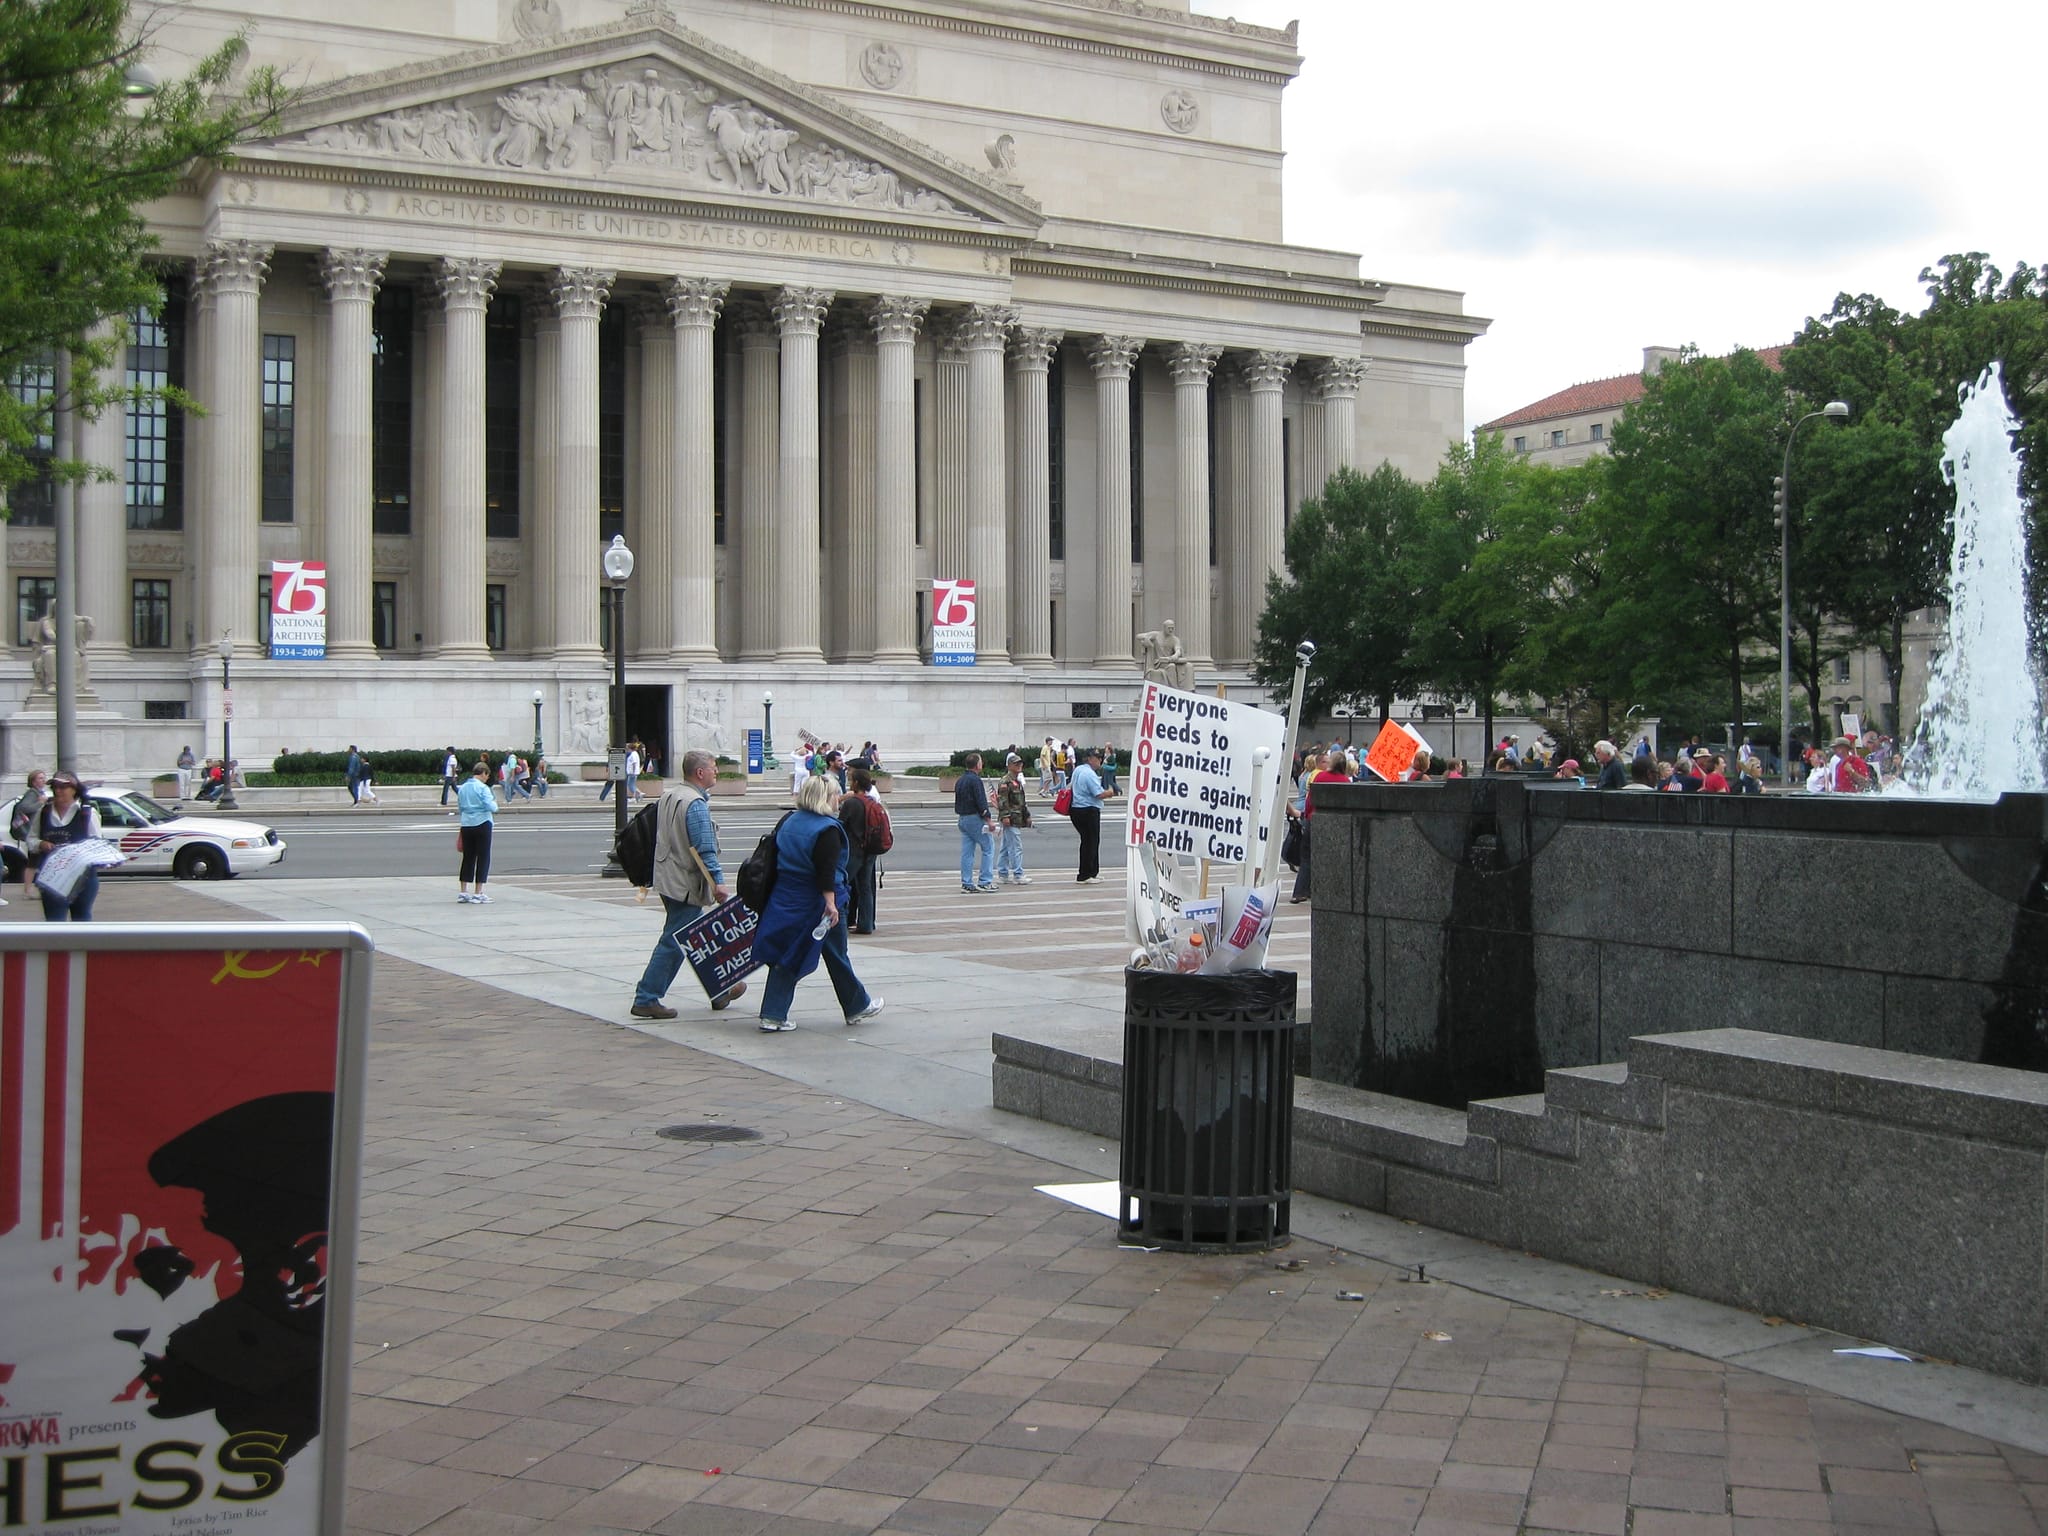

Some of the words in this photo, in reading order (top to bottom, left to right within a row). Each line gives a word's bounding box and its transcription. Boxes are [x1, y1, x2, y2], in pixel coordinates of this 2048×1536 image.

[396, 197, 505, 224] ARCHIVES
[514, 207, 540, 226] OF
[547, 211, 586, 231] THE
[594, 215, 672, 239] UNITED
[679, 223, 746, 246] STATES
[753, 231, 777, 248] OF
[783, 237, 875, 259] AMERICA
[272, 561, 326, 614] 75
[933, 580, 975, 626] 75
[274, 618, 325, 628] NATIONAL
[934, 630, 975, 638] NATIONAL
[274, 631, 326, 641] ARCHIVES
[934, 641, 976, 649] ARCHIVES
[1211, 729, 1229, 751] to
[1200, 785, 1252, 811] agains
[690, 938, 722, 965] THE
[714, 945, 753, 980] ERVE
[69, 1420, 137, 1441] presents
[171, 1514, 201, 1527] Lyrics
[205, 1513, 219, 1525] by
[220, 1510, 242, 1521] Tim
[246, 1507, 269, 1518] Rice
